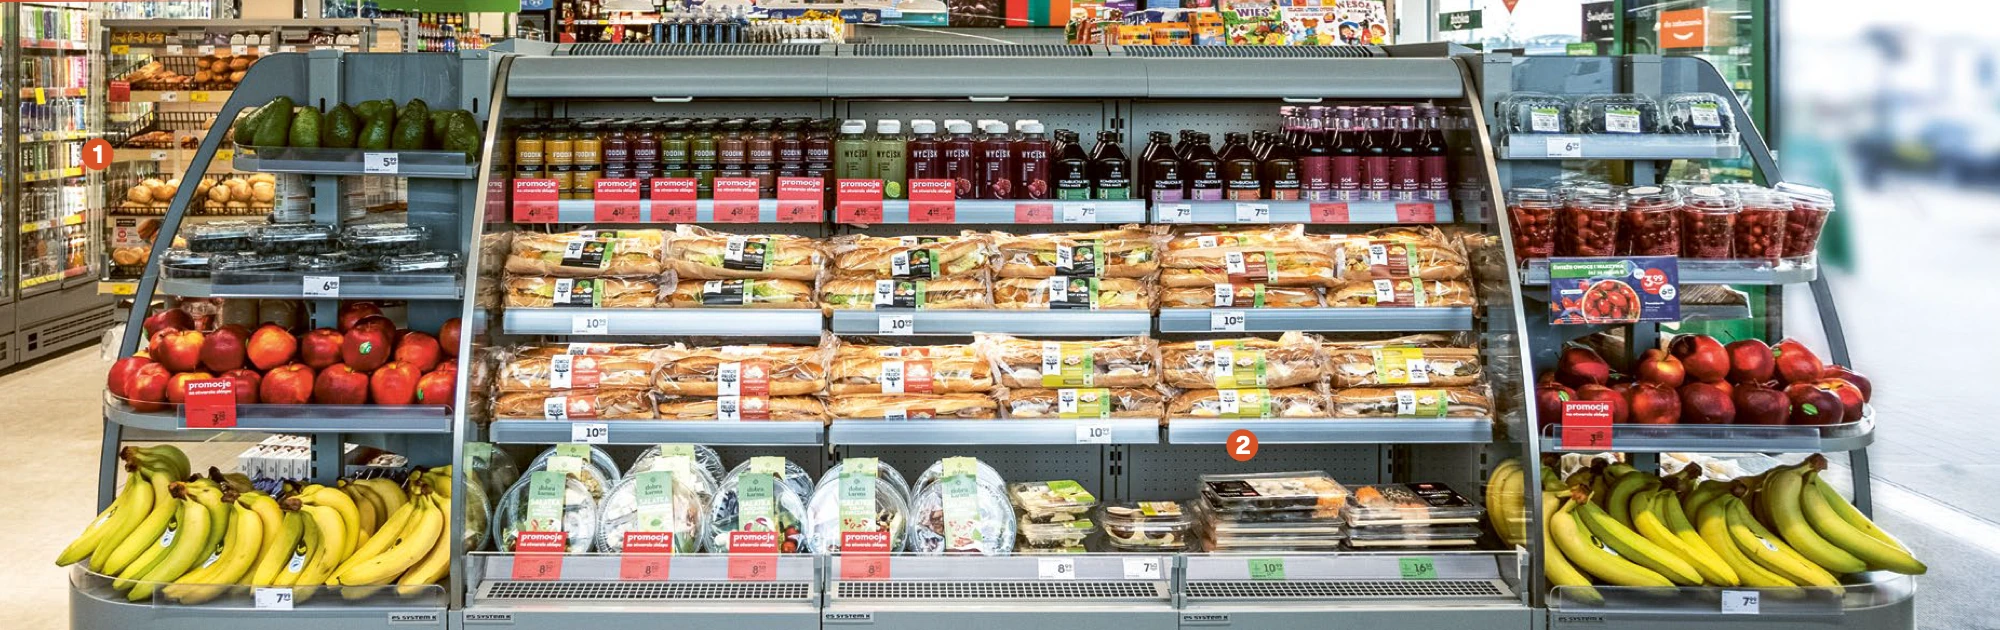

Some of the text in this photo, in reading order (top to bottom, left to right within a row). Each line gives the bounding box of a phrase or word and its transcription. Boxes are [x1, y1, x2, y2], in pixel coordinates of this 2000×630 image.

[1236, 7, 1270, 17] WIEŚ
[844, 150, 868, 159] WYCISK
[877, 150, 901, 159] WYCISK
[913, 150, 937, 159] WYCISK
[945, 149, 969, 159] WYCISK
[986, 150, 1010, 159] WYCISK
[1022, 150, 1046, 159] WYCISK
[517, 180, 556, 189] promocje
[597, 180, 637, 189] promocje
[654, 180, 693, 188] promocje
[717, 180, 756, 188] promocje
[781, 179, 820, 187] promocje
[840, 180, 880, 189] promocje
[912, 180, 951, 189] promocje
[188, 379, 231, 390] promocje
[1566, 403, 1608, 412] promocje
[520, 533, 562, 542] promocje
[627, 533, 669, 542] promocje
[733, 533, 774, 542] promocje
[845, 533, 886, 542] promocje
